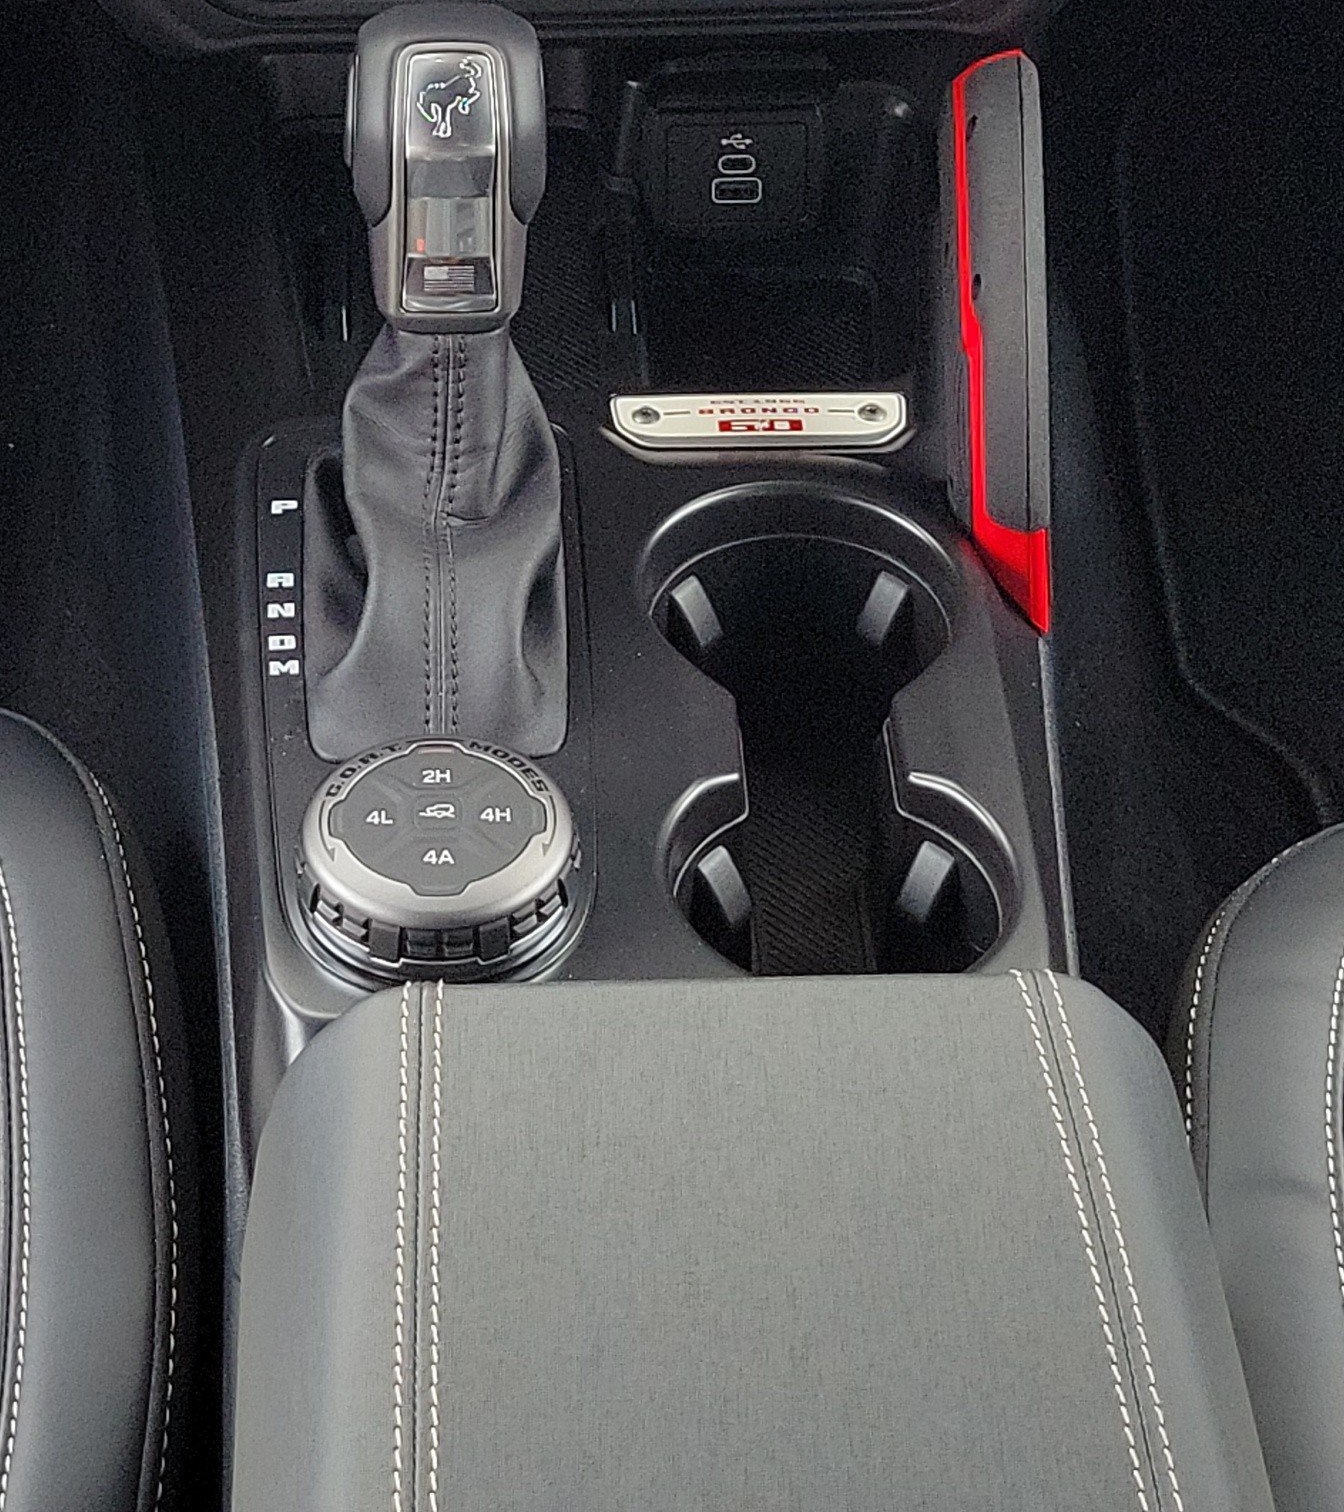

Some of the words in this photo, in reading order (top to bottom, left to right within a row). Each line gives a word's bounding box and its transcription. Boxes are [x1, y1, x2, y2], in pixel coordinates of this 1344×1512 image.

[271, 499, 299, 515] P
[266, 602, 296, 619] N
[267, 633, 297, 651] D
[268, 659, 300, 677] M
[468, 740, 551, 793] MODES
[421, 768, 452, 784] 2H
[365, 809, 394, 825] 4L
[479, 806, 513, 823] 4H
[422, 849, 455, 865] 4A
